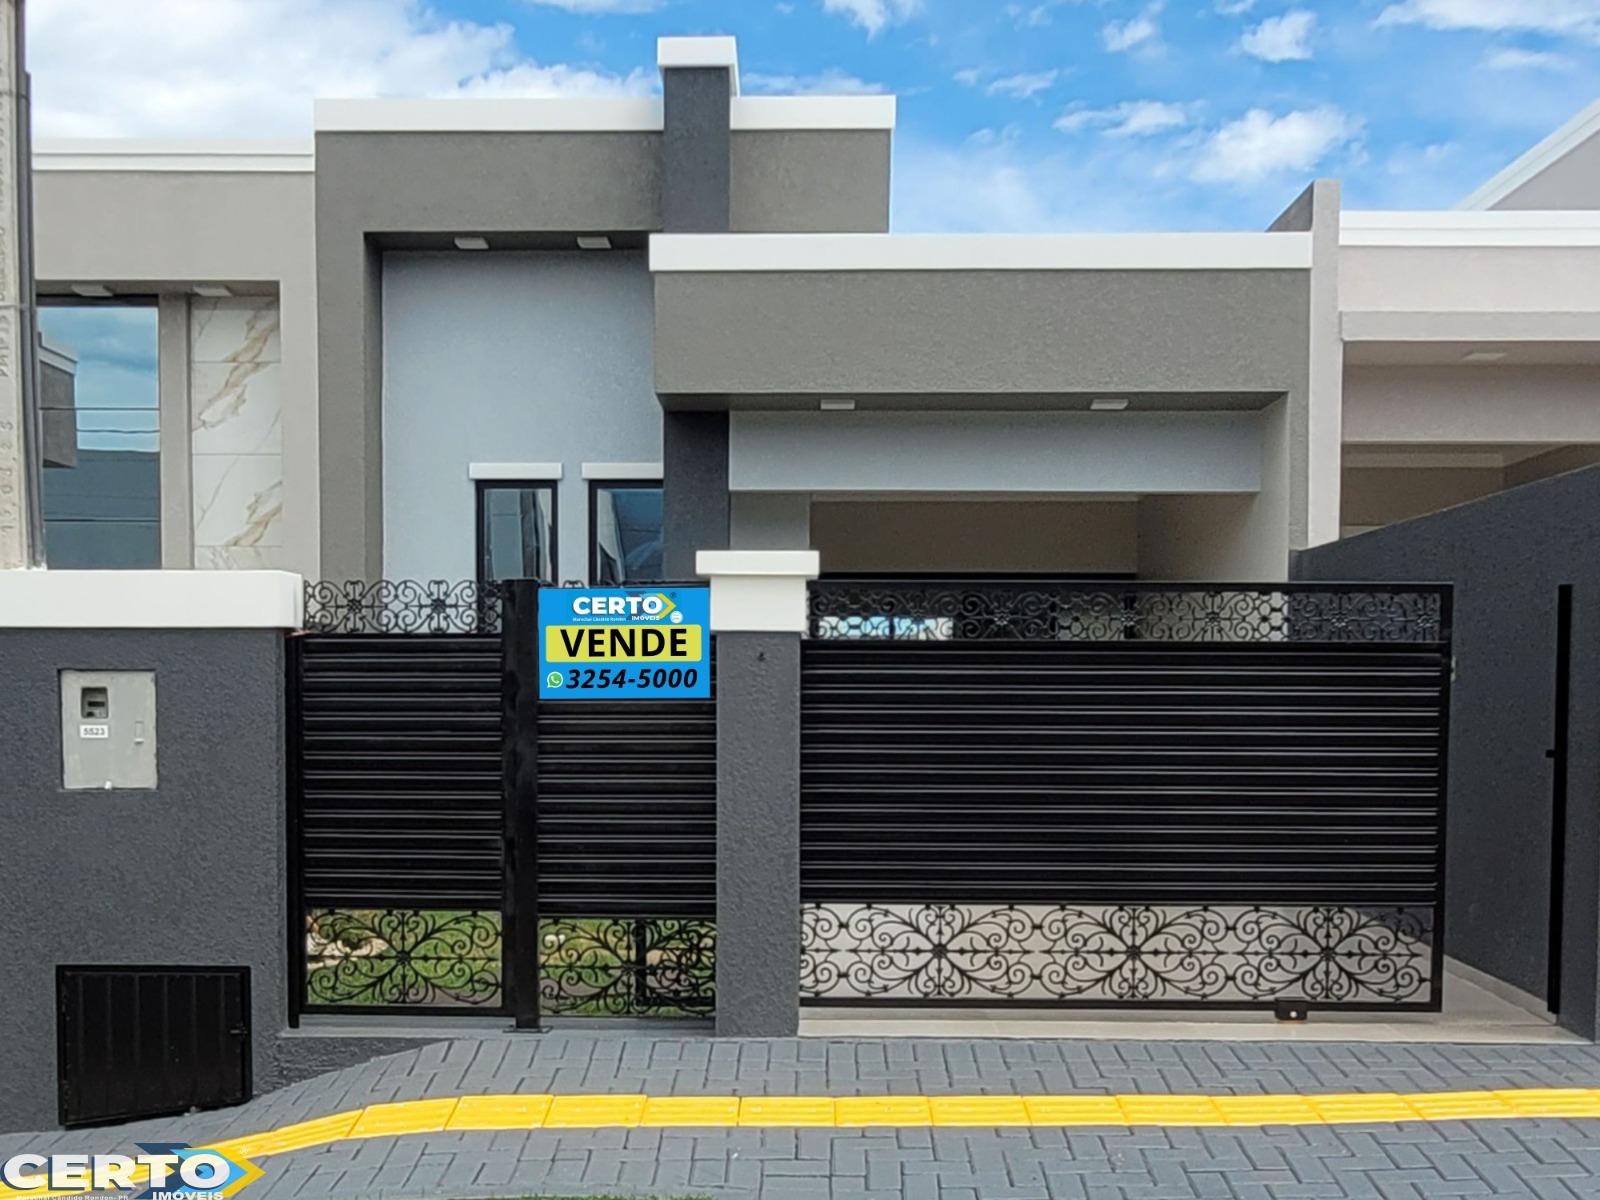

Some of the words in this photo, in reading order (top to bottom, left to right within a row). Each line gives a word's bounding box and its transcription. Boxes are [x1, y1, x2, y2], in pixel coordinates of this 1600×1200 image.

[572, 596, 663, 615] CERTO
[560, 628, 687, 657] VENDE
[566, 668, 698, 689] 3254-5000
